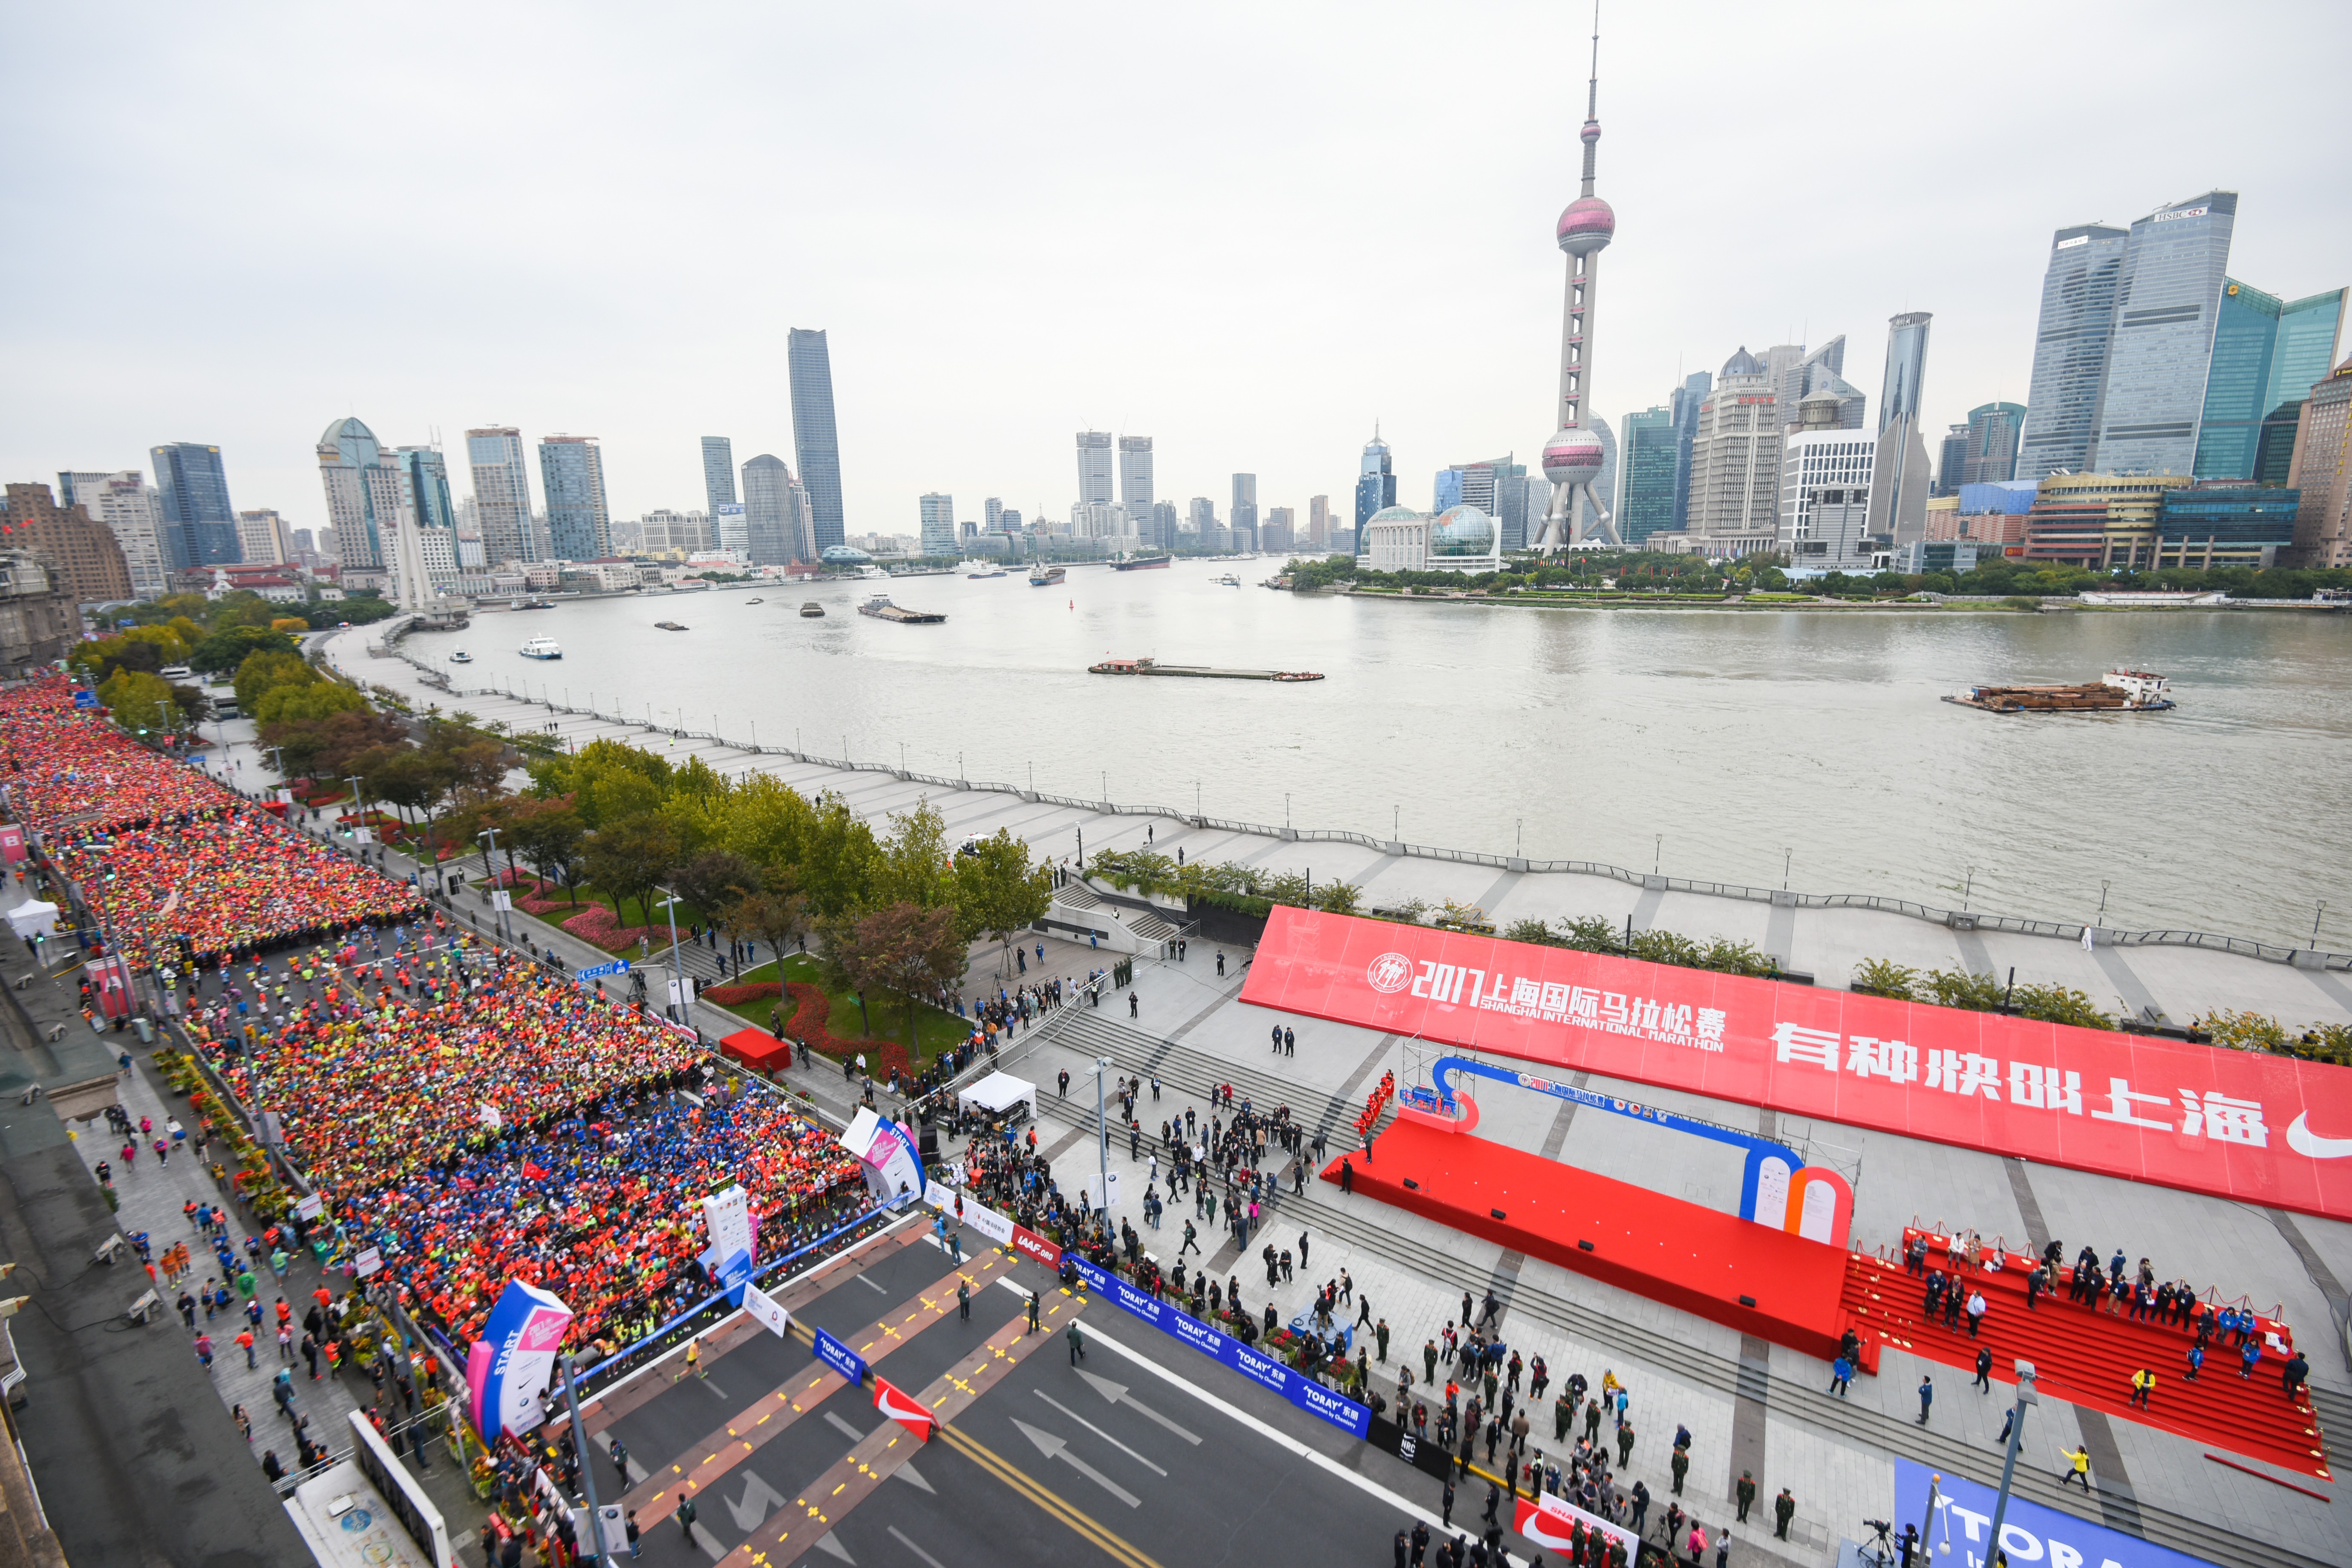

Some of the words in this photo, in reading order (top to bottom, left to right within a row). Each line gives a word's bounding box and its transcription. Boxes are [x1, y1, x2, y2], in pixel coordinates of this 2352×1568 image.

[2159, 210, 2187, 221] HSBC
[5, 835, 19, 847] B
[1479, 999, 1543, 1019] SHANGHAI
[1543, 1010, 1645, 1039] INTERNATIONAL
[1648, 1029, 1724, 1053] MARATHON
[890, 1127, 910, 1149] START
[1089, 1280, 1104, 1291] Chemistry
[1094, 1273, 1106, 1285] 东丽
[1120, 1297, 1136, 1310] Innovation
[1141, 1311, 1158, 1322] Chemistry
[1147, 1302, 1160, 1315] 东丽
[1177, 1328, 1195, 1342] Innovation
[1201, 1341, 1219, 1355] Chemistry
[1208, 1334, 1221, 1347] 东丽
[494, 1329, 520, 1376] START
[821, 1350, 836, 1363] Innovation
[840, 1363, 854, 1377] Chemistry
[845, 1356, 856, 1370] 东丽
[1238, 1362, 1258, 1376] Innovation
[1259, 1372, 1264, 1380] by
[1264, 1375, 1283, 1391] Chemistry
[1271, 1367, 1286, 1383] 东丽
[1306, 1400, 1328, 1415] Innovation
[1328, 1410, 1335, 1419] by
[1335, 1414, 1356, 1430] Chemistry
[1342, 1405, 1359, 1421] 东丽
[1401, 1438, 1416, 1454] NRC
